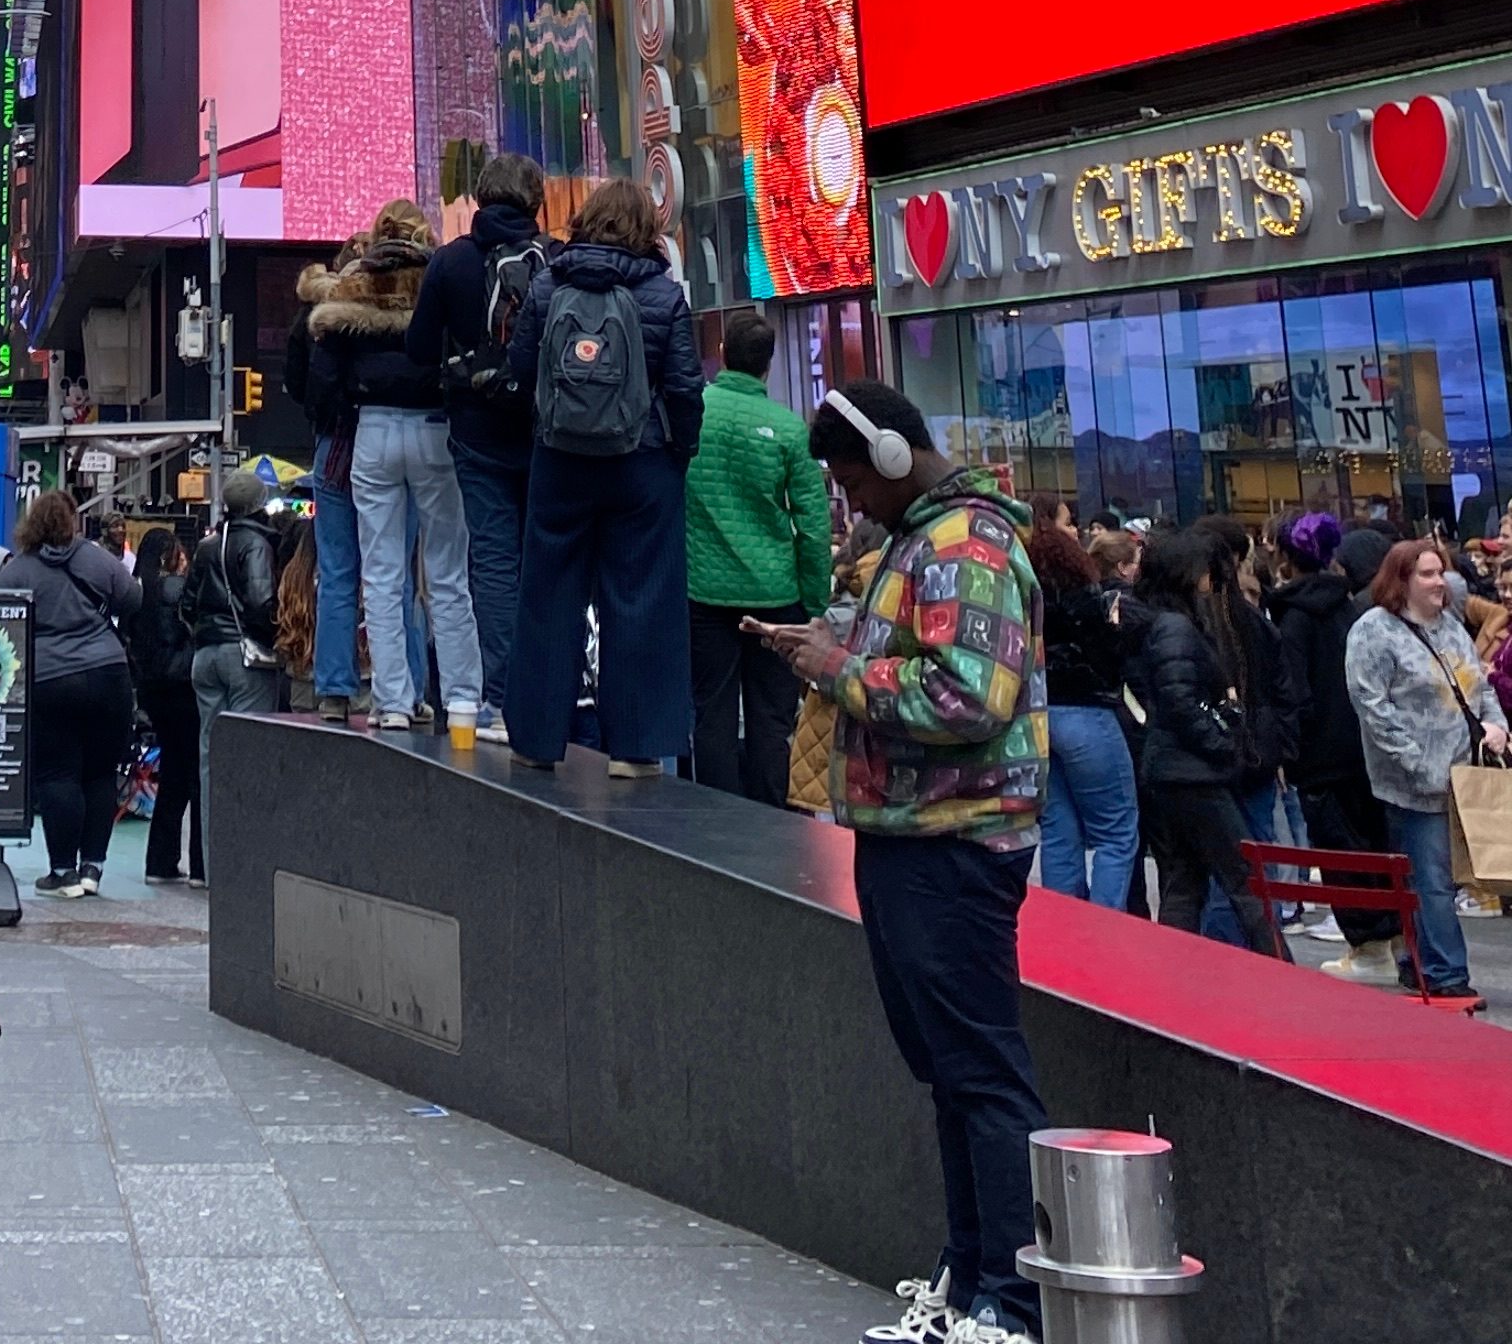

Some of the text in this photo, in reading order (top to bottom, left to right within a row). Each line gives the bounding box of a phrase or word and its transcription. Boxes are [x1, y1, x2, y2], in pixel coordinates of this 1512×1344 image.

[952, 172, 1057, 282] NY
[1071, 129, 1312, 265] GIFTS
[1450, 86, 1512, 211] N
